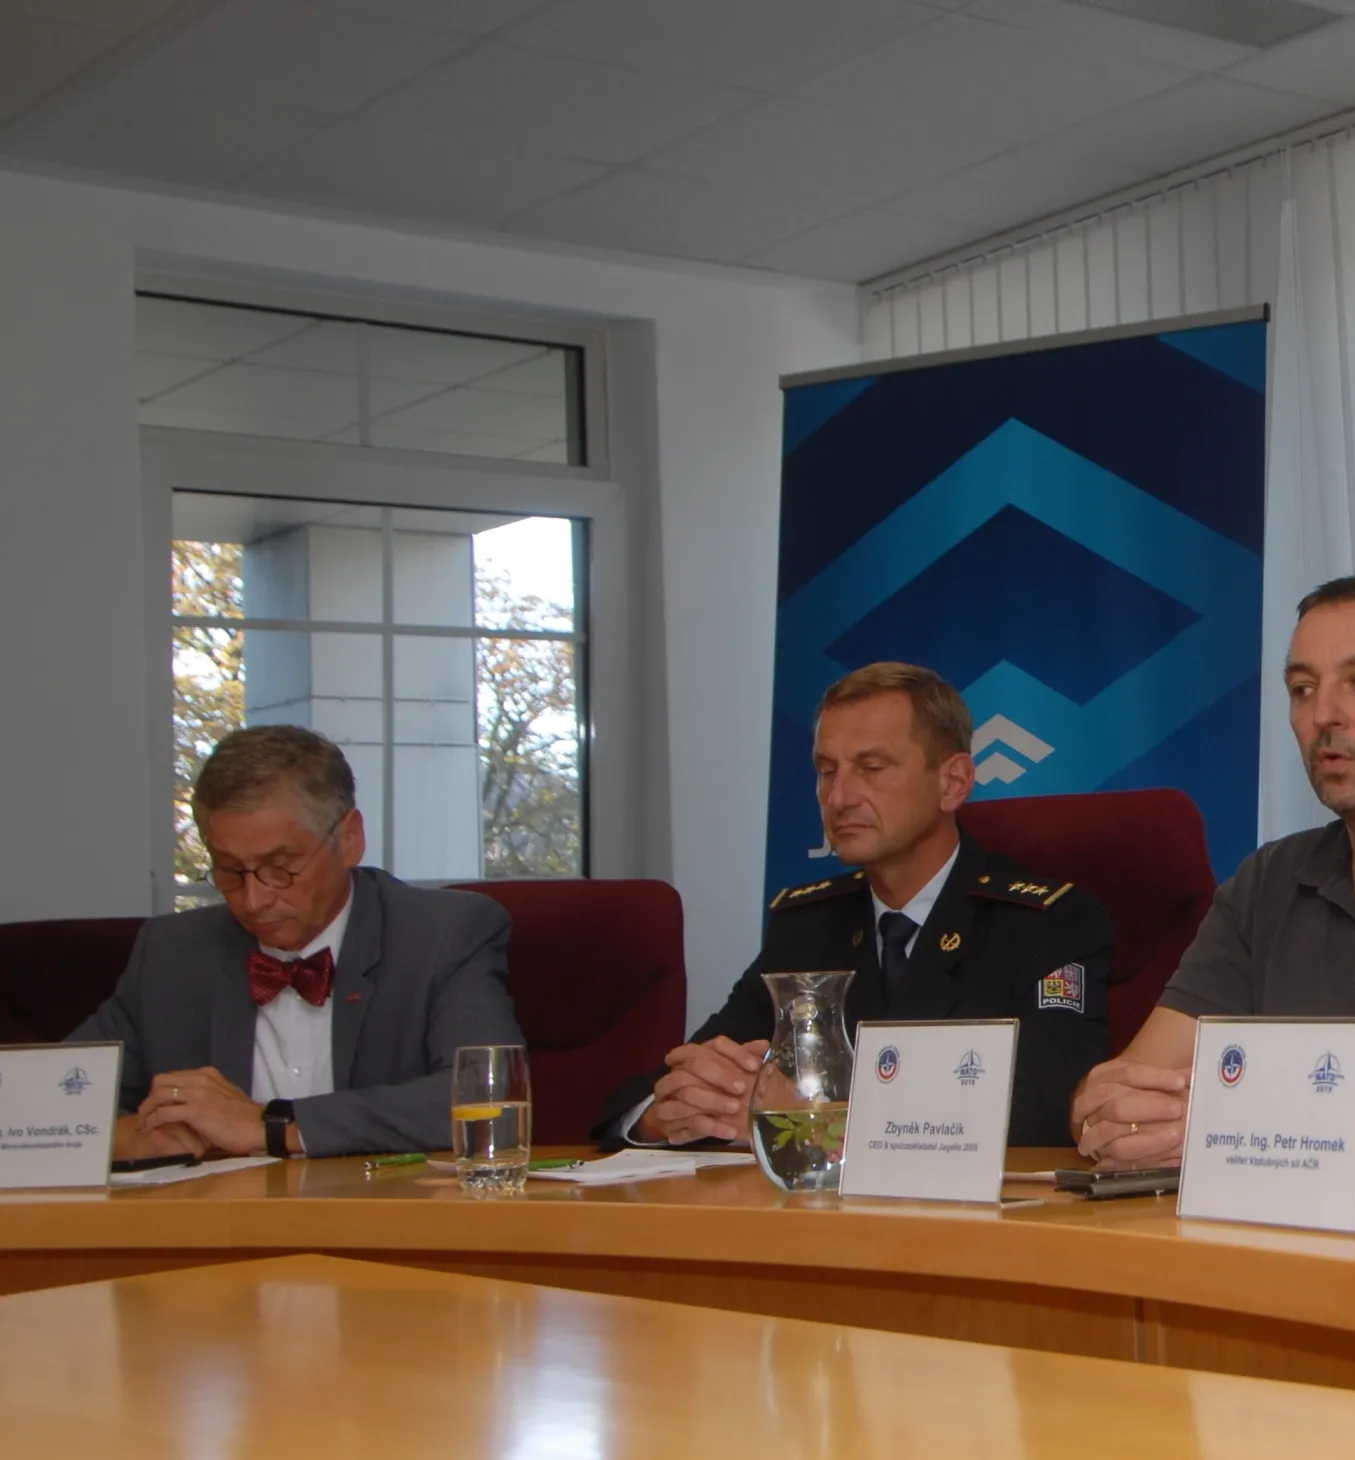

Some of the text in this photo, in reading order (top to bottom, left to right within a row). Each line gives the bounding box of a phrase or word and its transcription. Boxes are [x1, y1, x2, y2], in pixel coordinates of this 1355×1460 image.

[1042, 997, 1081, 1009] POLICIE
[960, 1068, 978, 1076] NATO
[1316, 1072, 1335, 1081] NATO
[8, 1126, 24, 1137] Ivo
[884, 1121, 920, 1137] Zbyněk
[868, 1140, 883, 1150] CEO
[1205, 1132, 1346, 1153] genmjr. Ing. Petr Hromek
